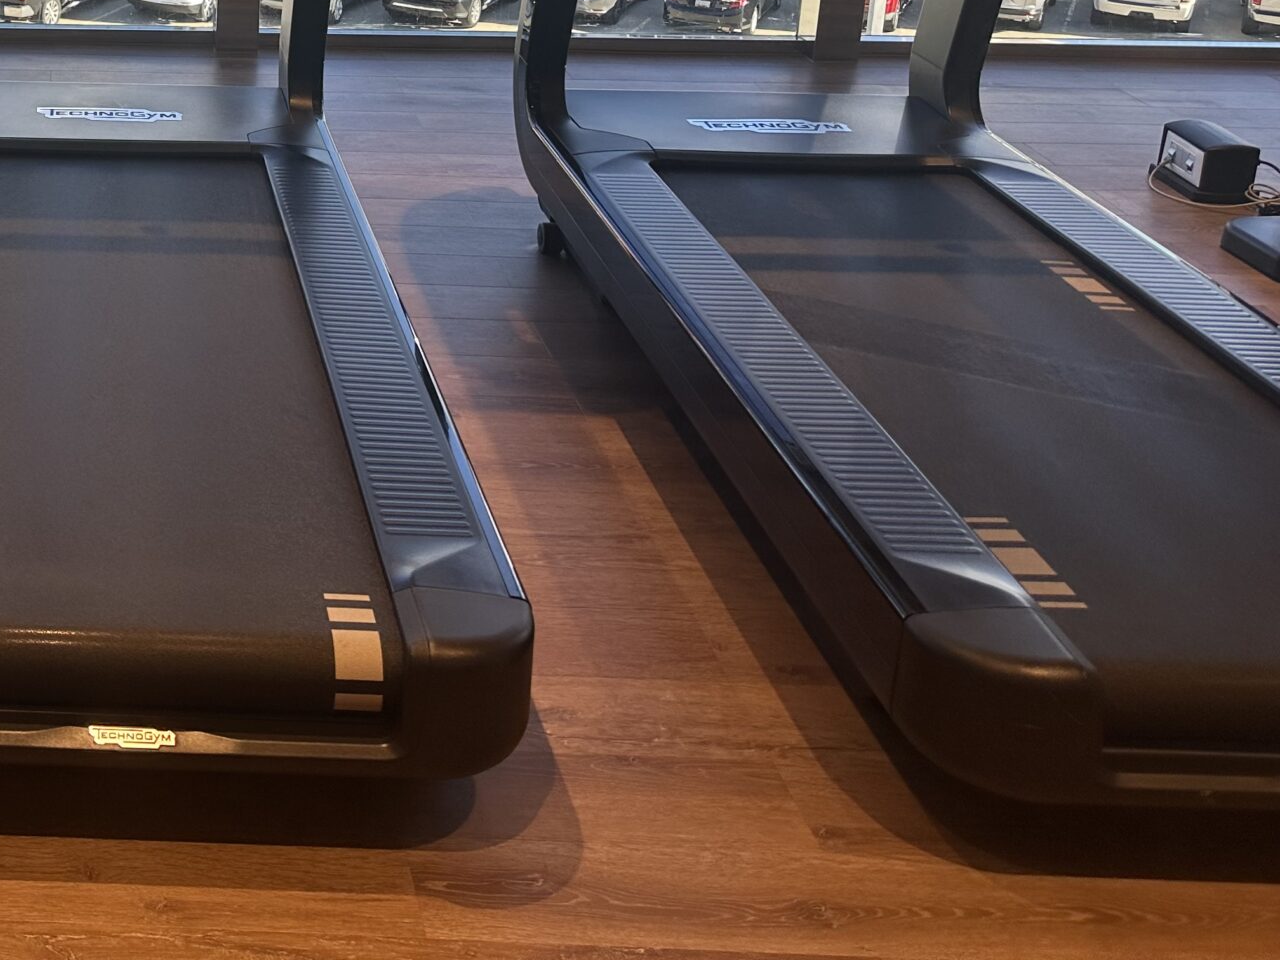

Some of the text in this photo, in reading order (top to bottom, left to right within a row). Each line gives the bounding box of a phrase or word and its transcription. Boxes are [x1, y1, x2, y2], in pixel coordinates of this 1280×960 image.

[39, 107, 178, 120] TECHNOGYM
[692, 119, 845, 131] TECHNOGYM
[92, 727, 172, 744] TECHNOGYM
